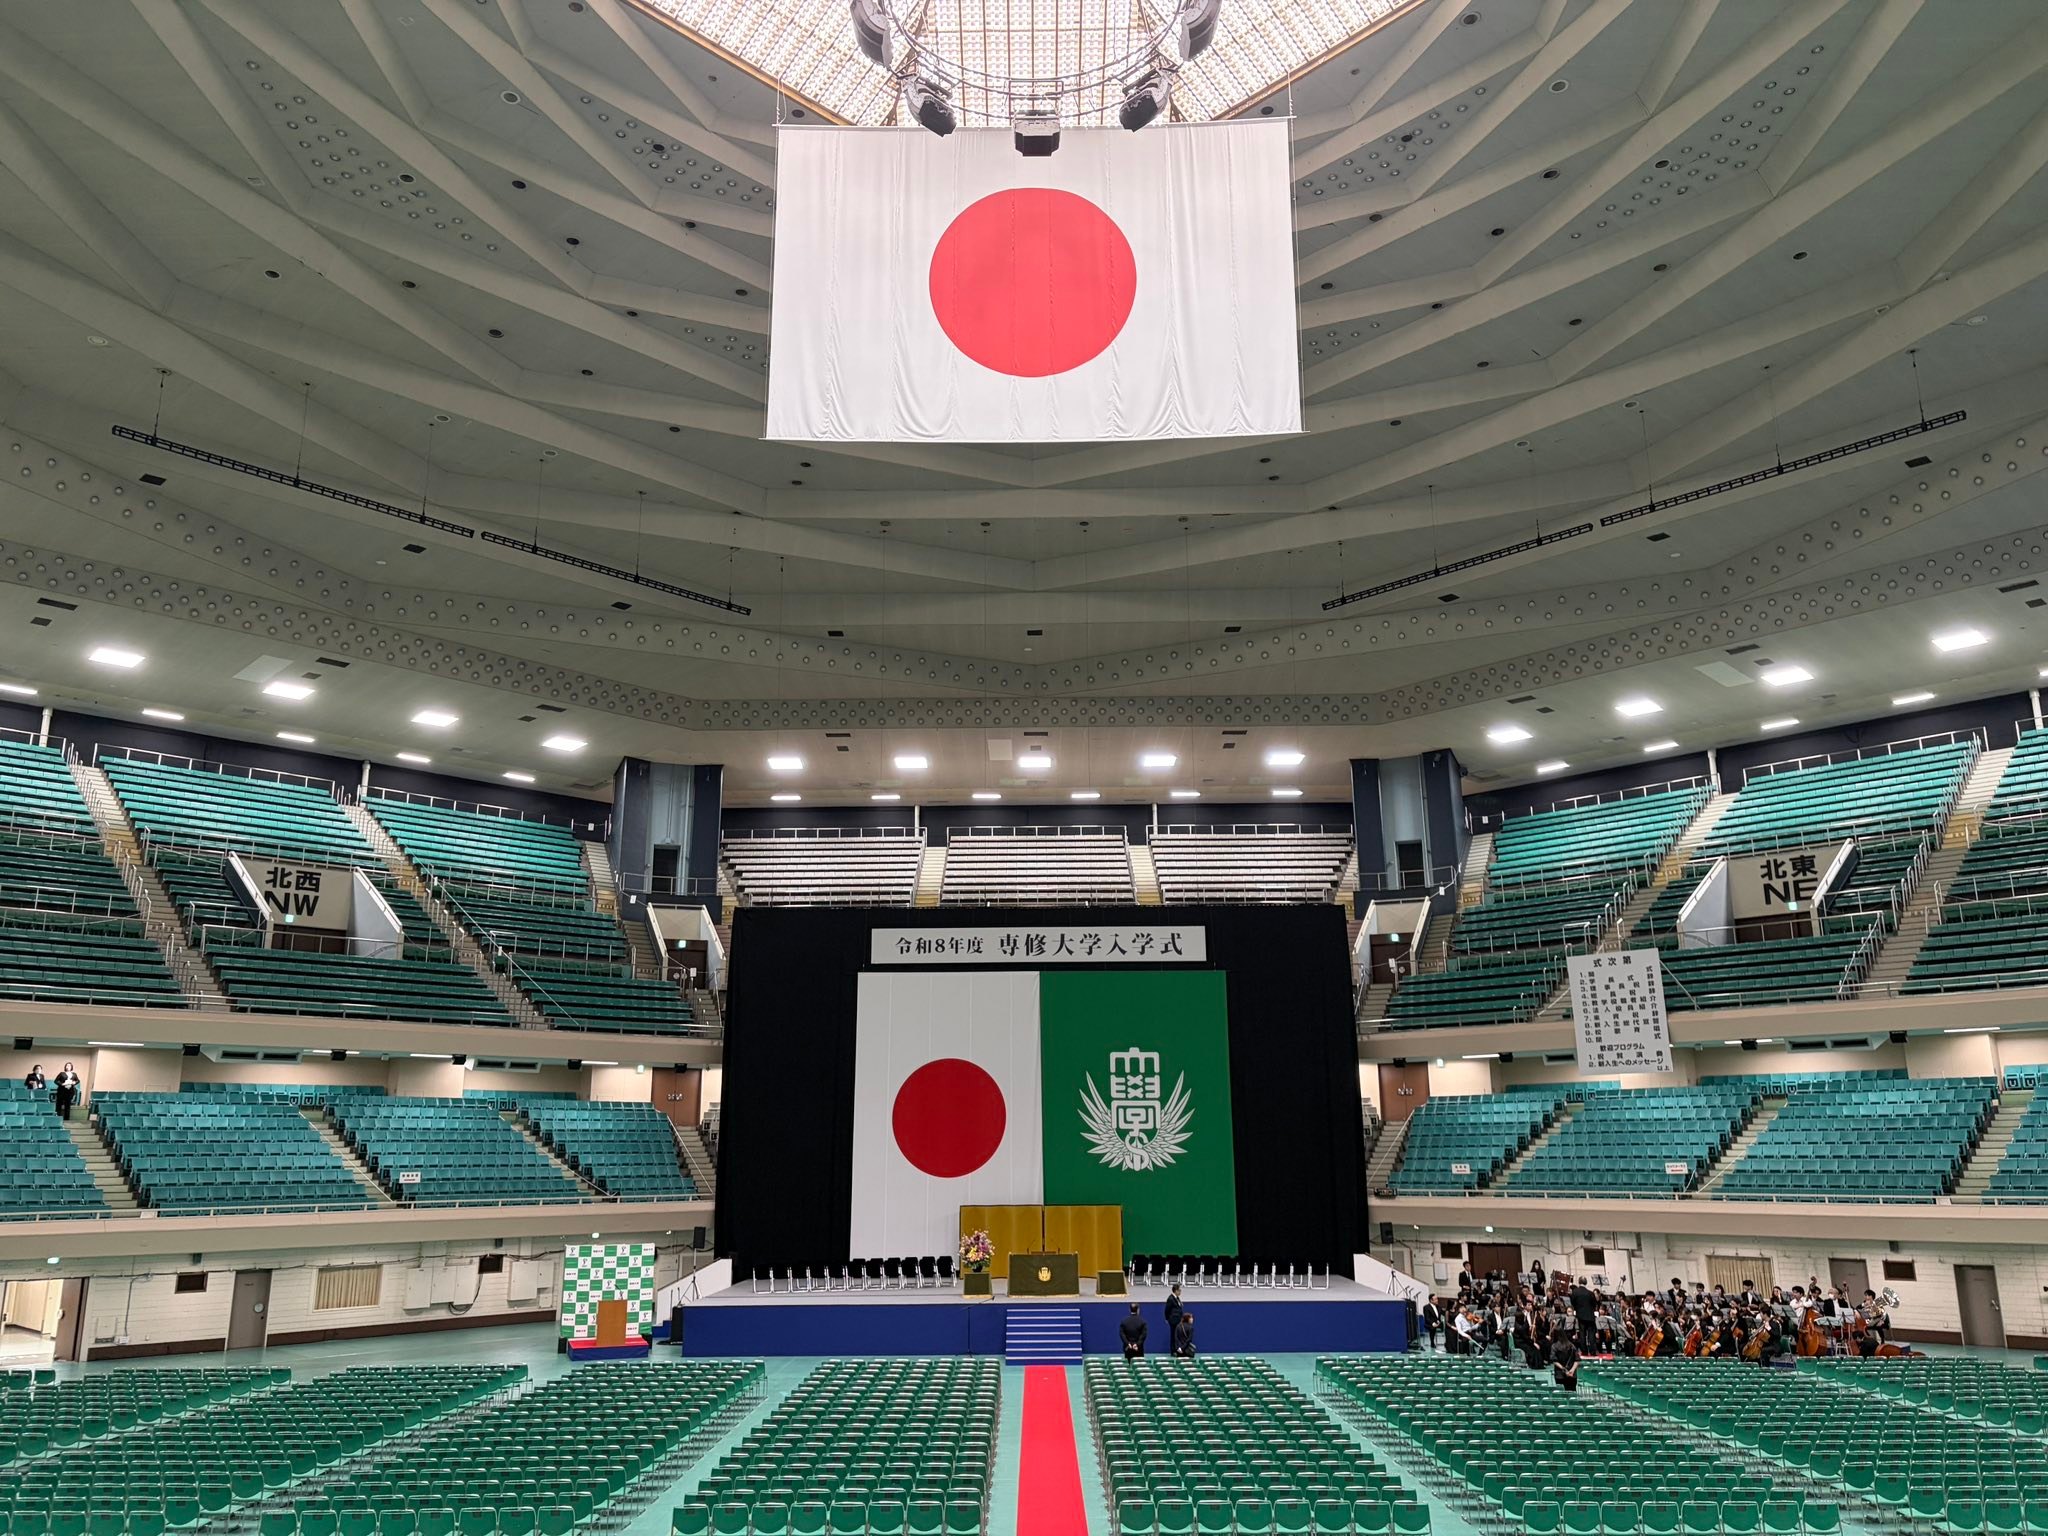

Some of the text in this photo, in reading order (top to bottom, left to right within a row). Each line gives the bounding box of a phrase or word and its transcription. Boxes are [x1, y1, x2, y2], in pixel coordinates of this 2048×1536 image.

[265, 867, 322, 893] 北西
[1760, 855, 1818, 881] 北東
[264, 891, 320, 916] NW
[1763, 878, 1818, 905] NE
[895, 932, 1183, 957] 令和8年度 専修大学入学式
